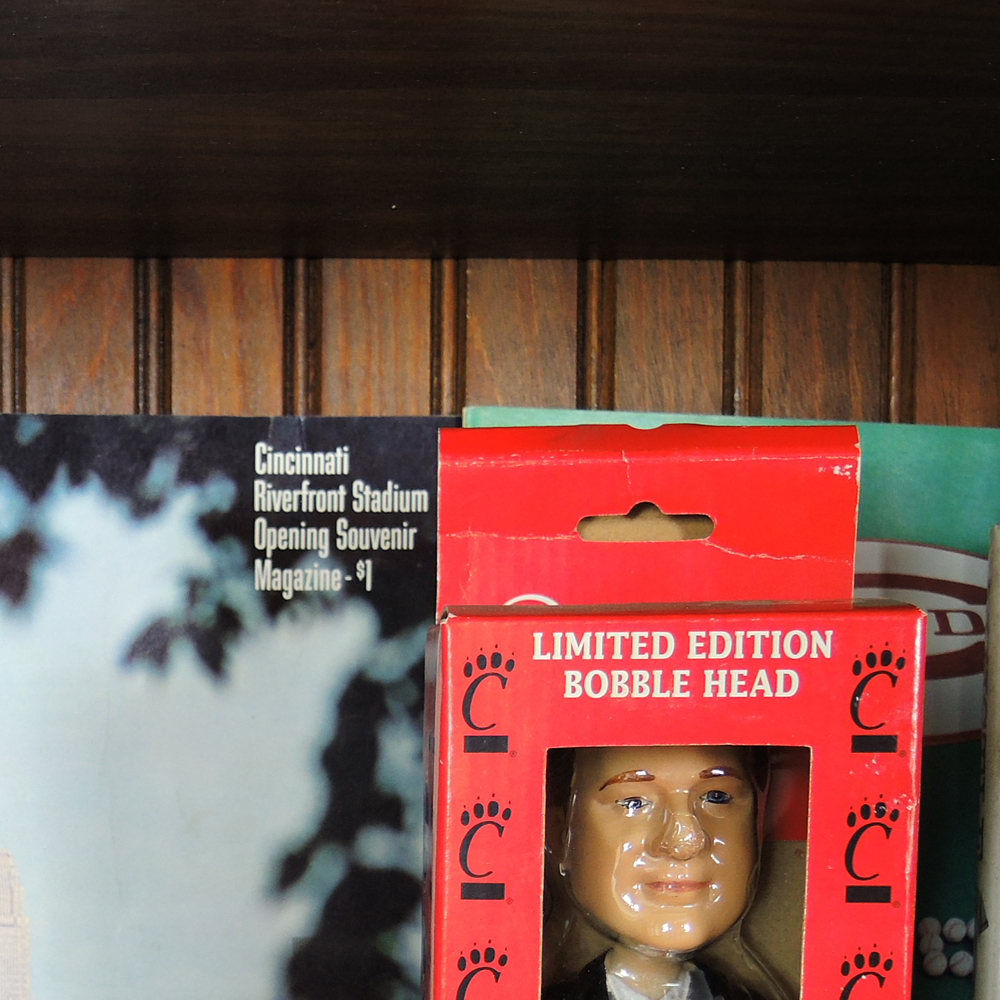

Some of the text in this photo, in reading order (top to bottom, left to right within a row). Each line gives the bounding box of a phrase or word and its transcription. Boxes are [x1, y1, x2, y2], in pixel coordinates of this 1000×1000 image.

[254, 441, 350, 476] Cincinnati
[253, 479, 429, 513] Riverfront Stadium
[254, 516, 418, 559] Opening Souvenir
[254, 558, 343, 600] Magazine
[356, 558, 373, 592] $1
[532, 629, 834, 661] LIMITED EDITION
[563, 669, 800, 699] BOBBLE HEAD
